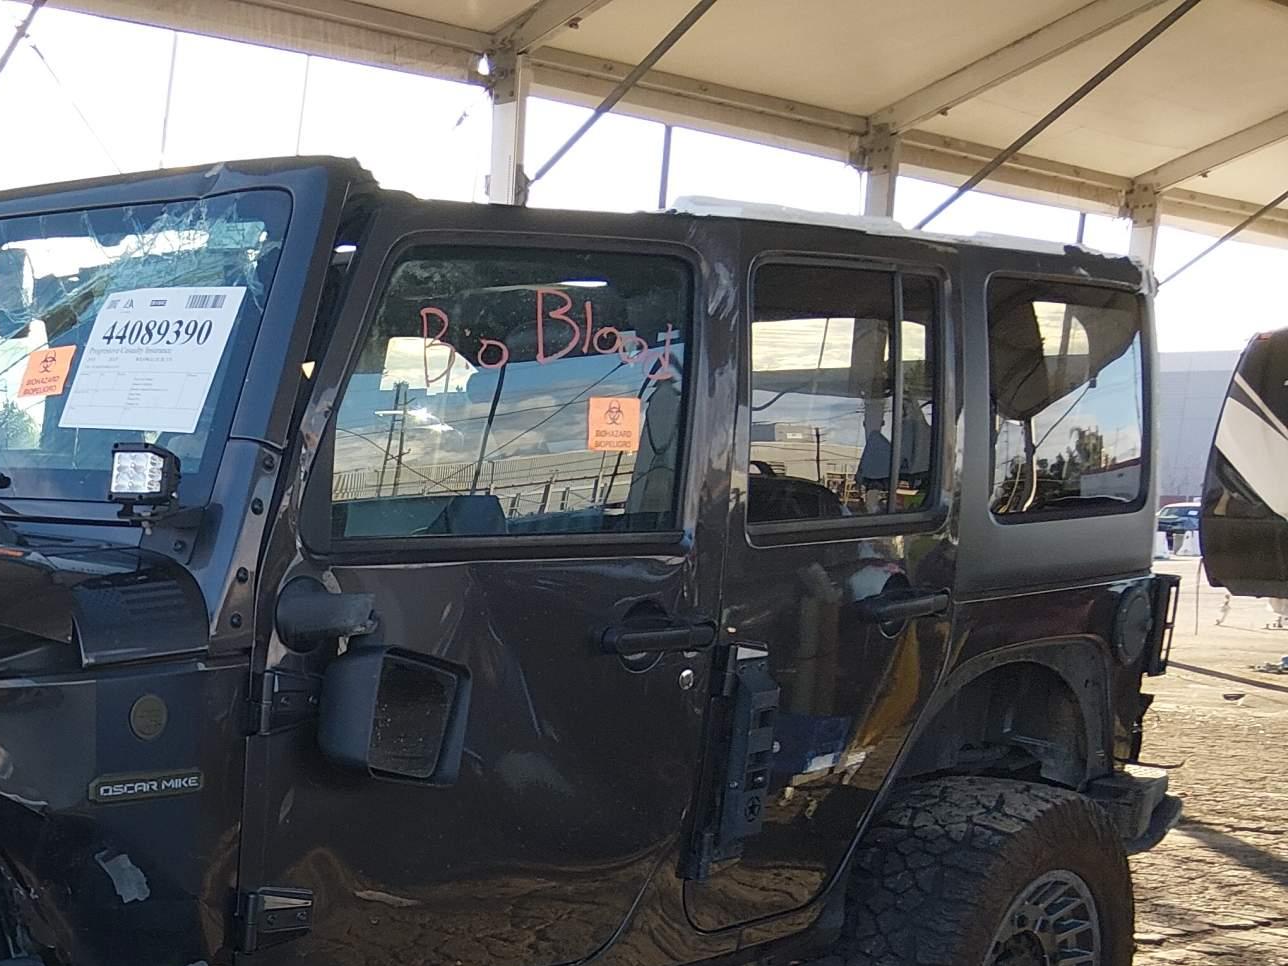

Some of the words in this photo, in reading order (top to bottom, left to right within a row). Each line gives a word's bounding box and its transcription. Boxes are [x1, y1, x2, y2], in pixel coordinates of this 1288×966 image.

[102, 319, 213, 346] 44089390
[595, 430, 633, 438] BIOHAZARD
[594, 440, 632, 448] BIOPELIGRO
[100, 781, 159, 796] OSCAR
[161, 776, 199, 790] MIKE
